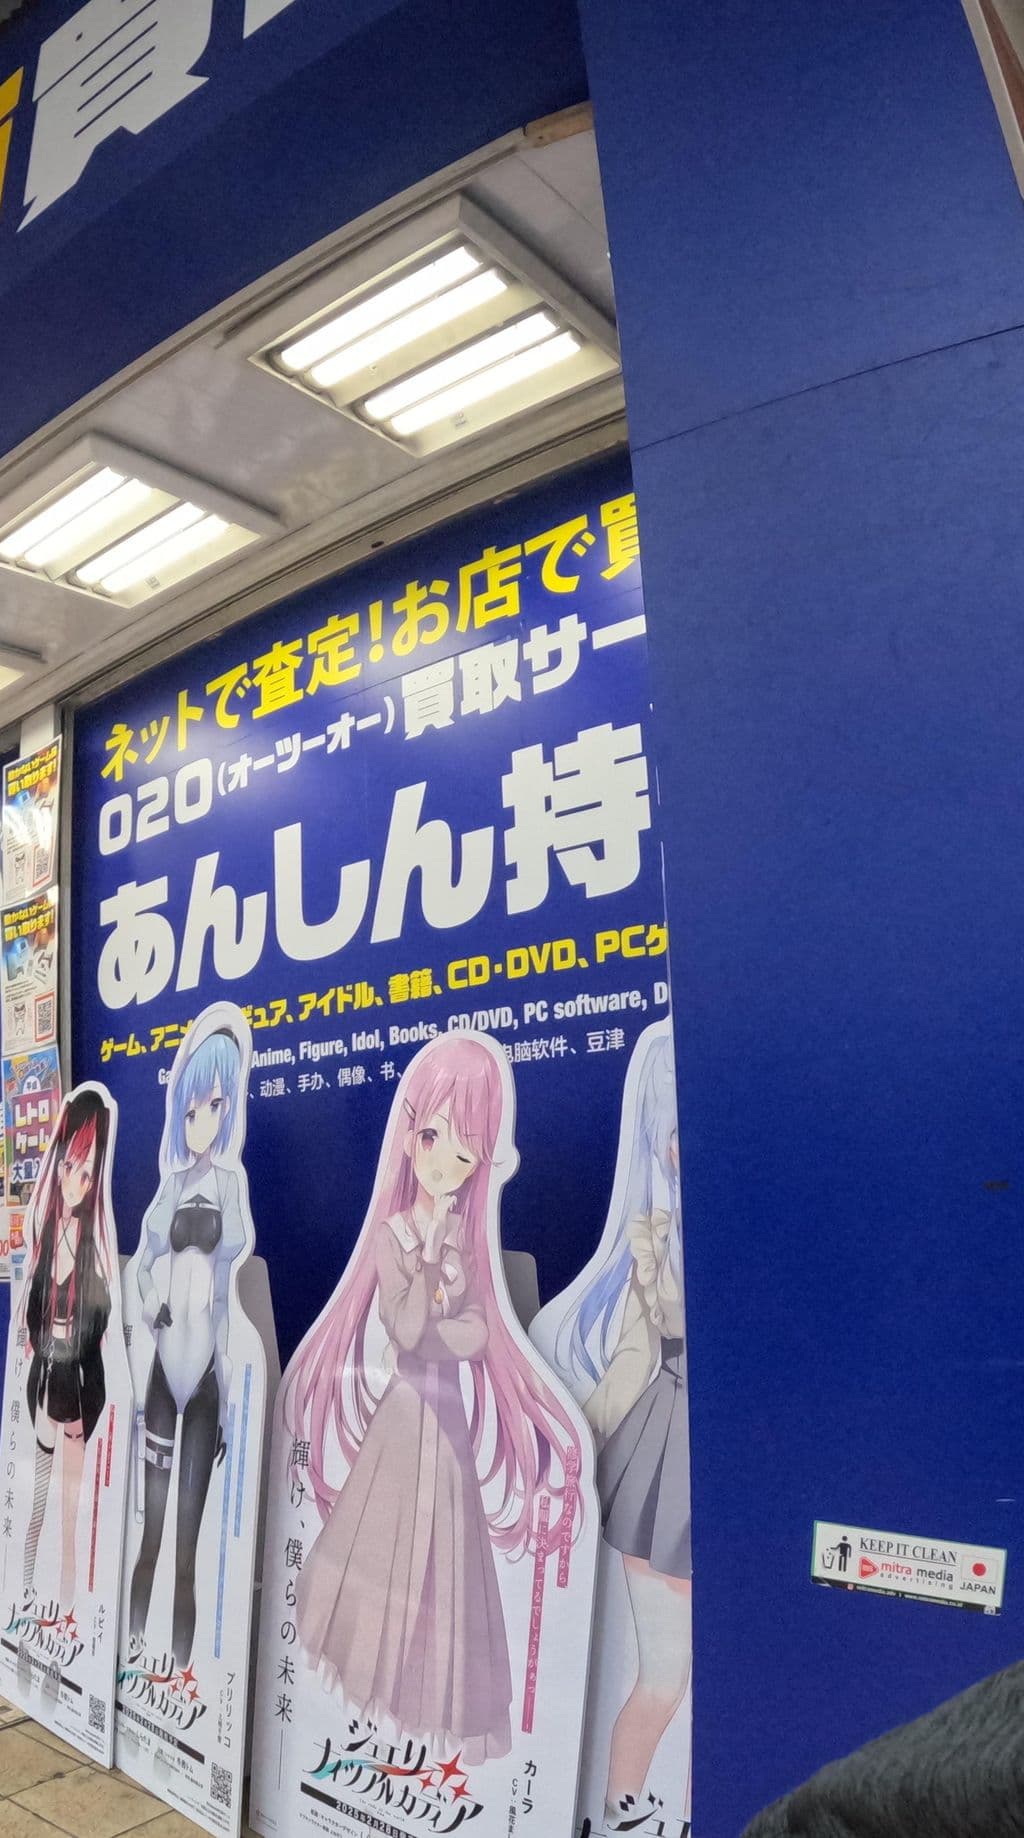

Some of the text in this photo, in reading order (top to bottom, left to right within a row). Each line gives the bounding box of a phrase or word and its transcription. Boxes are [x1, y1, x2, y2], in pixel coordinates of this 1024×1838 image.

[97, 722, 652, 1011] あんしん持
[299, 1036, 349, 1063] Figure,
[352, 1029, 385, 1054] Idol,
[447, 1006, 519, 1034] CD/DVD,
[524, 1003, 548, 1024] PC
[553, 987, 648, 1019] software,
[15, 1099, 50, 1128] レトロ
[859, 1536, 958, 1564] KEEP IT CLEAN
[879, 1572, 954, 1591] advertising
[881, 1561, 954, 1583] mitra media
[959, 1581, 997, 1595] JAPAN
[521, 1759, 537, 1814] カーラ
